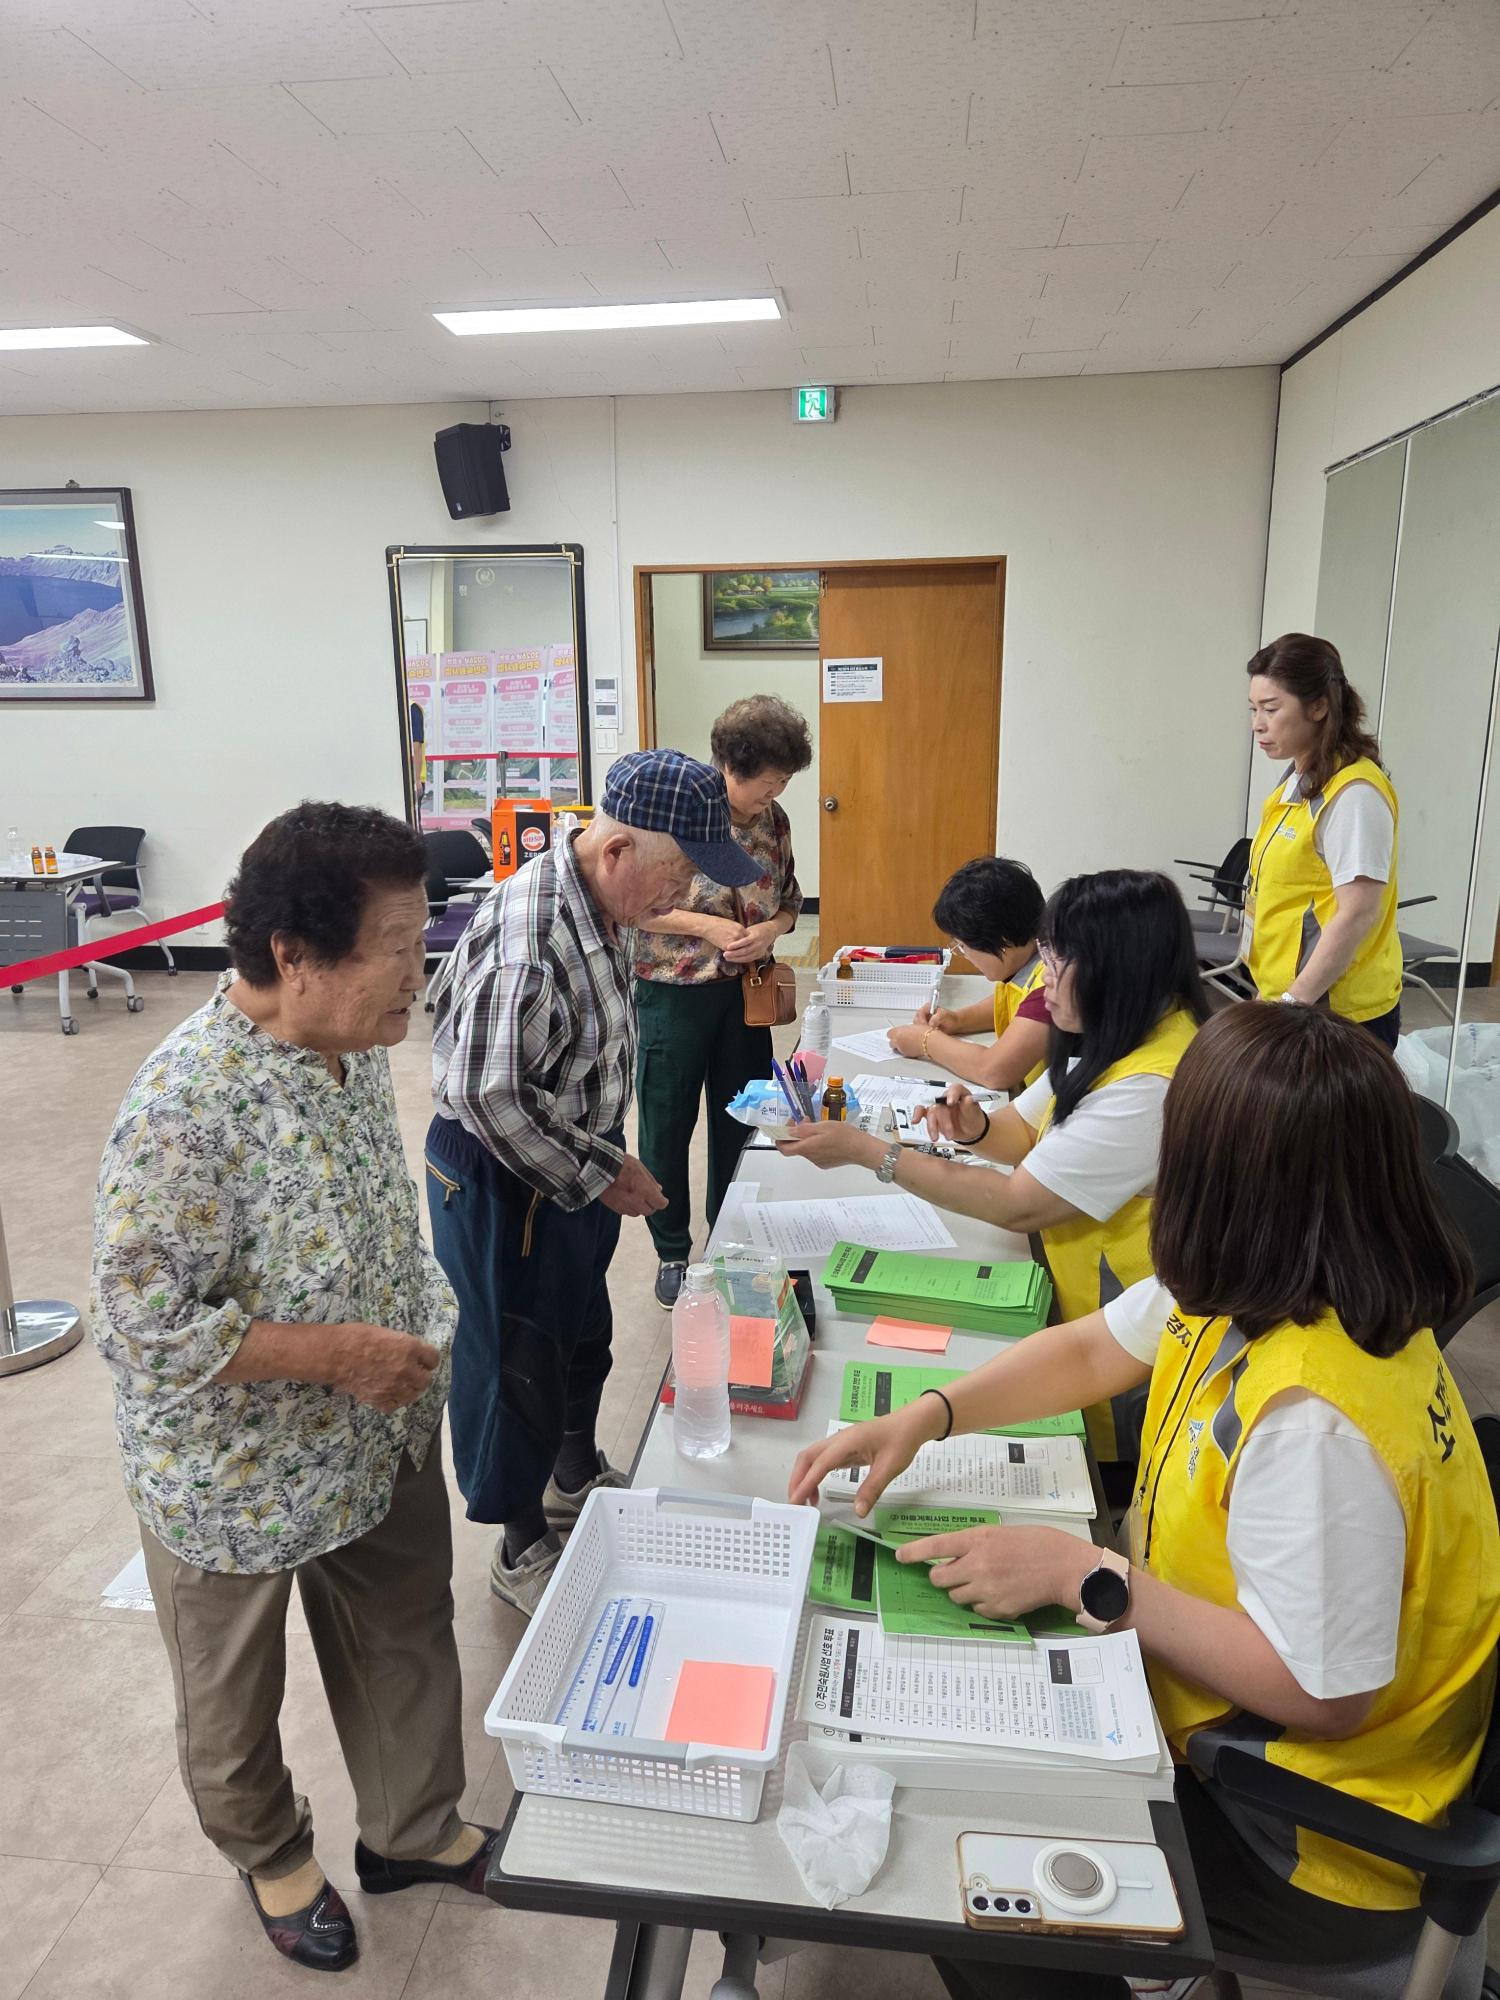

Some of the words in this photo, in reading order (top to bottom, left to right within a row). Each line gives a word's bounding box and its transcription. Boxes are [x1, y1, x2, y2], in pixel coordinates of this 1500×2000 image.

[761, 1106, 776, 1116] 순백
[823, 1628, 834, 1641] 투표
[821, 1642, 832, 1656] 선호
[816, 1657, 831, 1700] 주민숙원사업
[814, 1700, 826, 1709] ①
